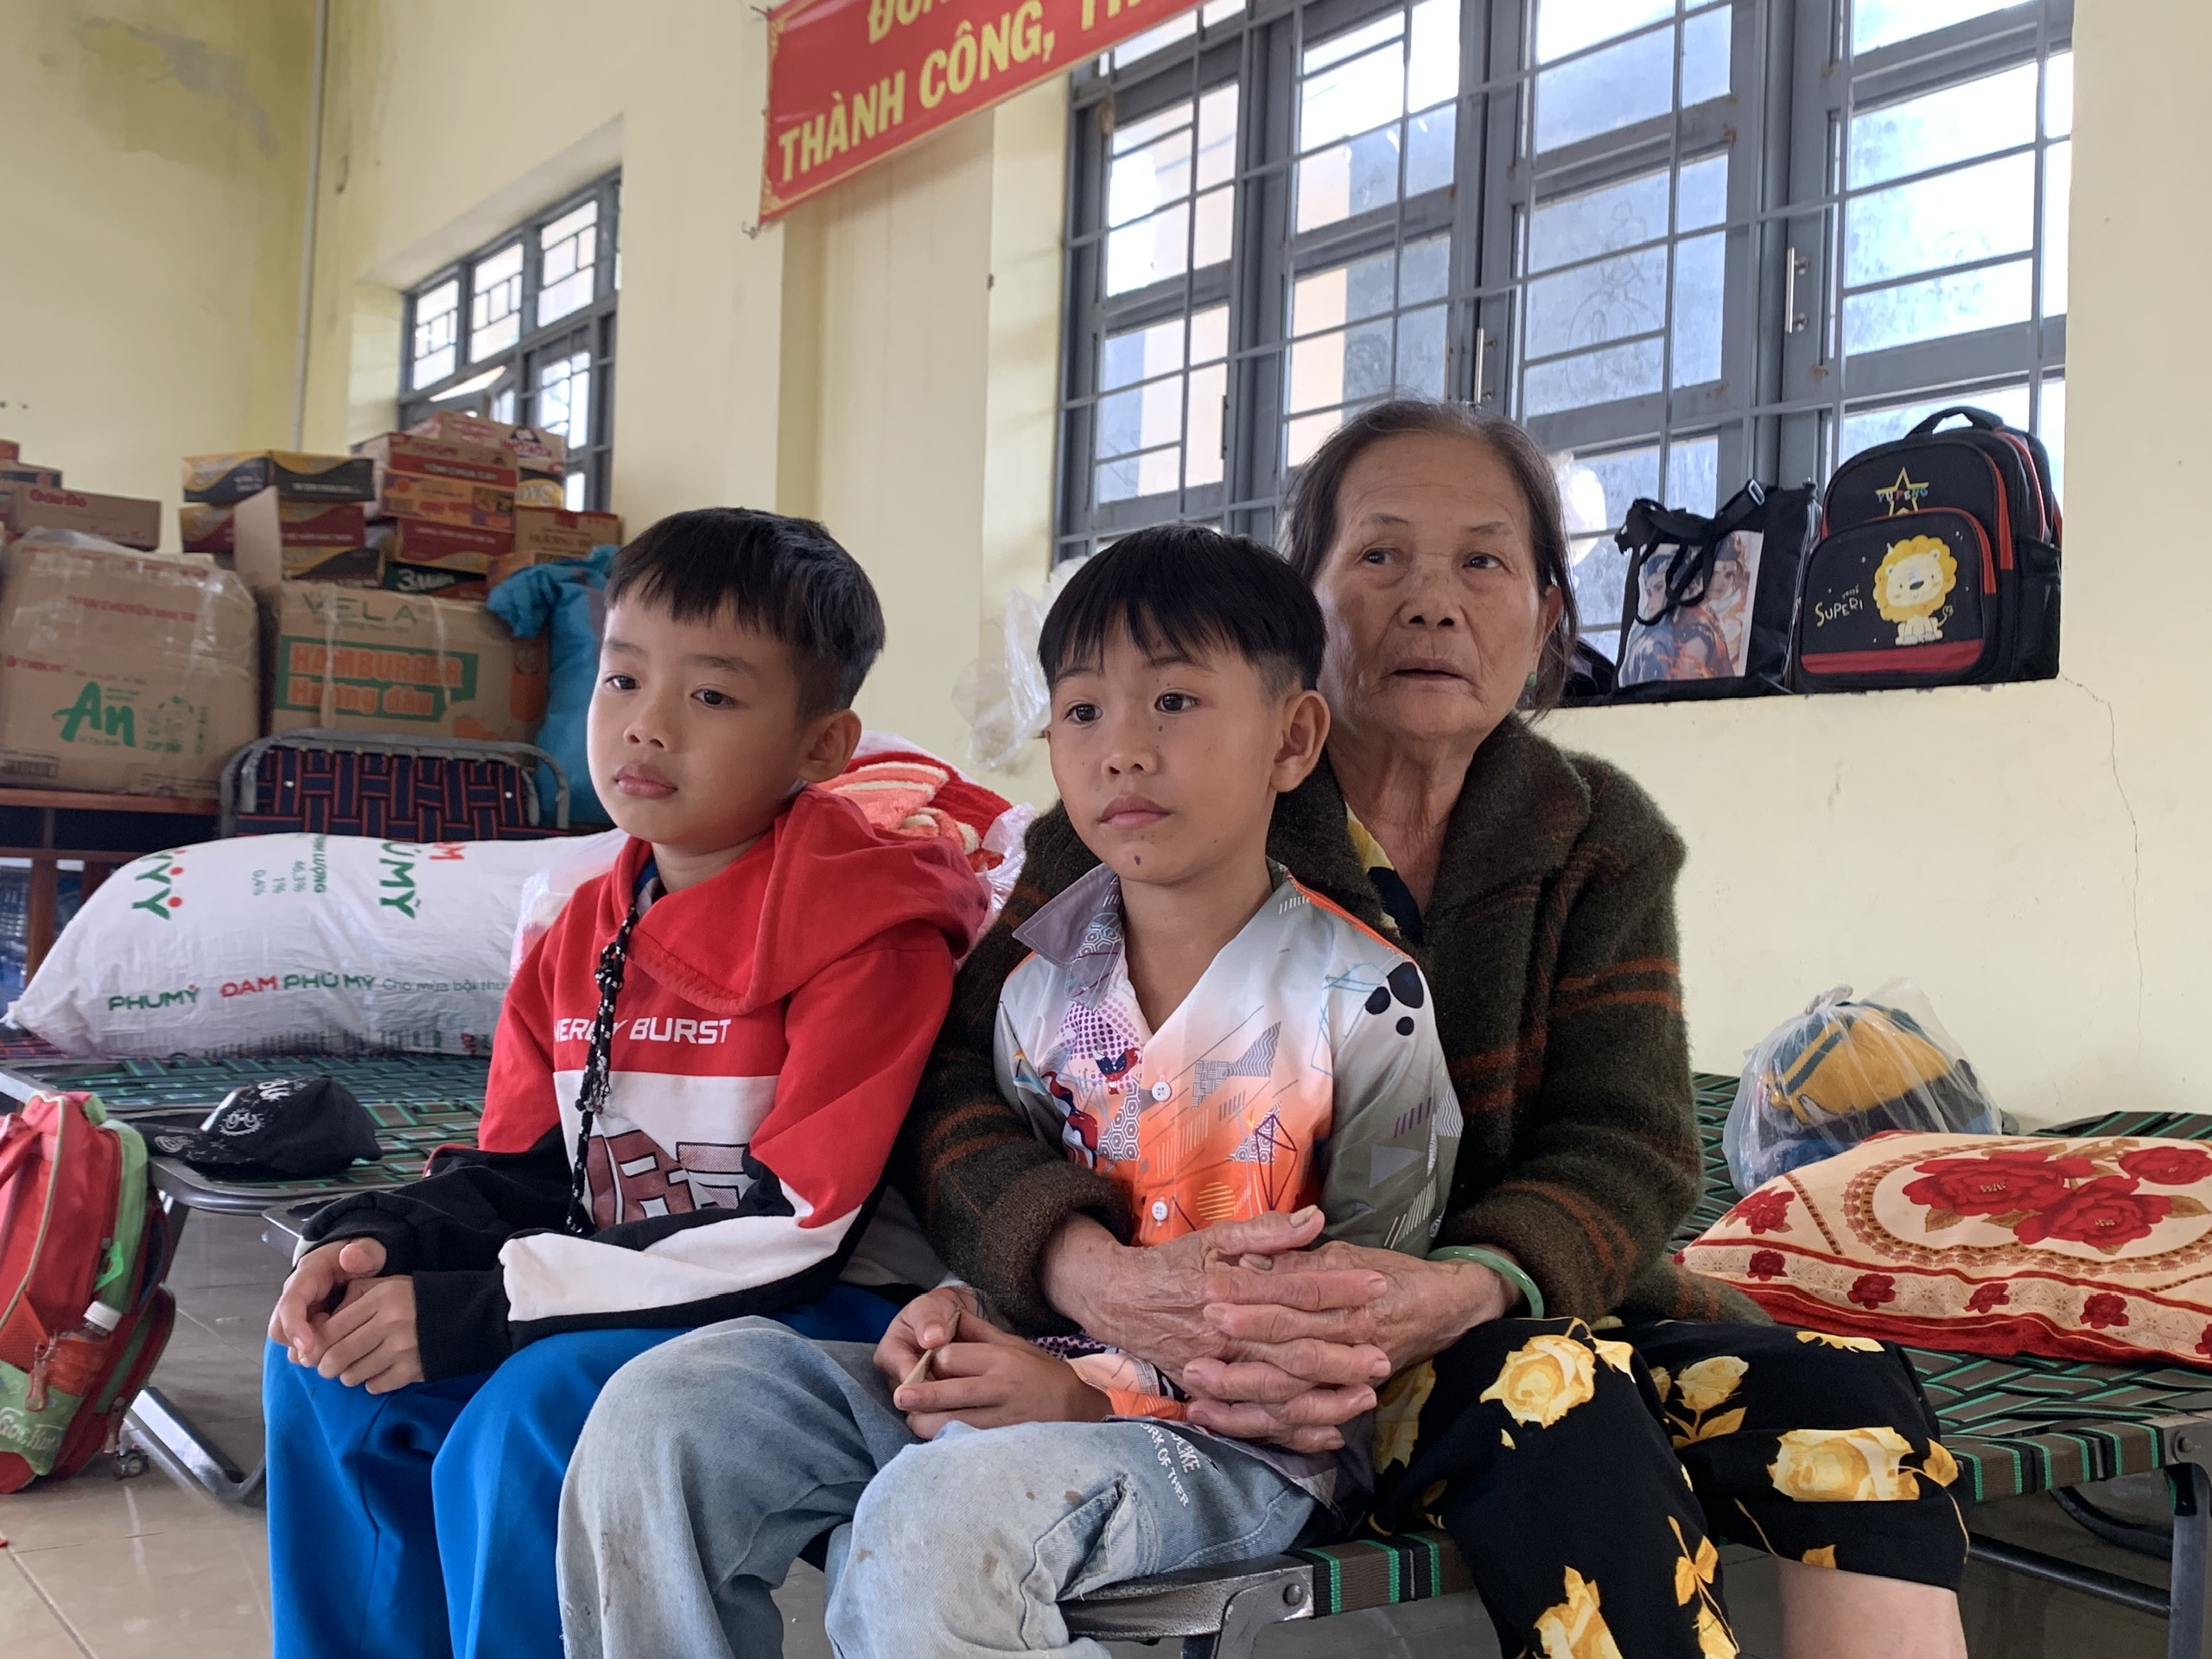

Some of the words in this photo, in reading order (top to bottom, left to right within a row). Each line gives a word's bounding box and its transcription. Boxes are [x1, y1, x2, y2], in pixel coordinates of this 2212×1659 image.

[779, 70, 906, 181] THÀNH
[919, 1, 1055, 109] CÔNG,
[303, 590, 417, 624] VELA
[289, 642, 462, 688] HAMBURGER
[53, 680, 137, 747] An
[629, 1016, 732, 1045] BURST
